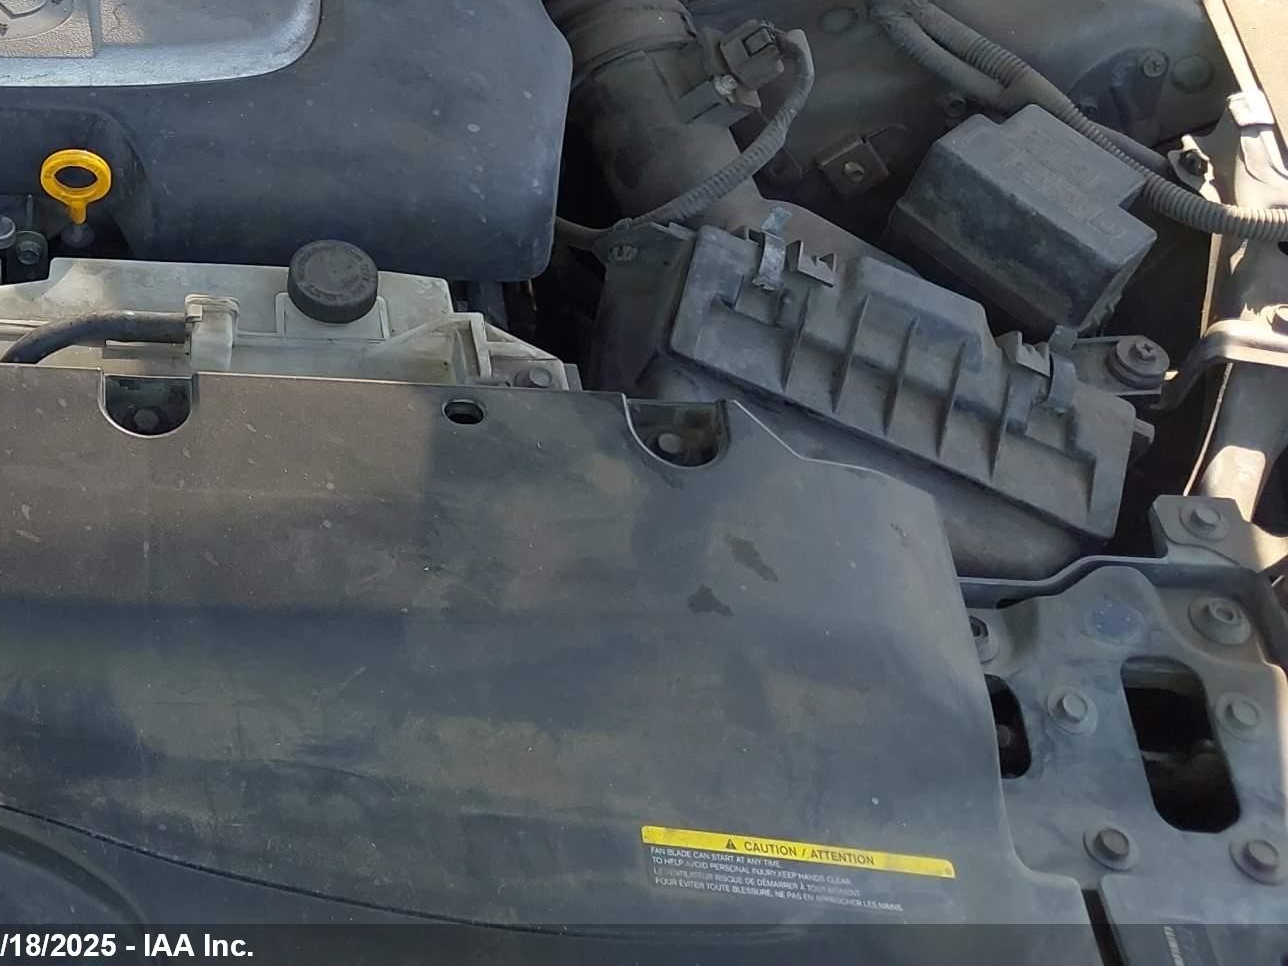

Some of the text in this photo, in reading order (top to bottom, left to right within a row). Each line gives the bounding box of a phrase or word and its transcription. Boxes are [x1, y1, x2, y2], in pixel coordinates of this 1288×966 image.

[650, 846, 666, 855] FAN
[666, 848, 692, 858] BLADE
[693, 851, 711, 860] CAN
[712, 854, 734, 863] START
[736, 856, 745, 864] AT
[747, 857, 762, 866] ANY
[743, 841, 797, 857] CAUTION
[811, 849, 875, 866] ATTENTION
[652, 856, 663, 865] TO
[664, 858, 685, 867] HELP
[710, 862, 751, 875] PERSONAL
[655, 877, 678, 886] POUR
[706, 882, 731, 892] TOUTE
[775, 890, 786, 899] NE
[786, 892, 802, 900] PAS
[745, 877, 756, 886] DE
